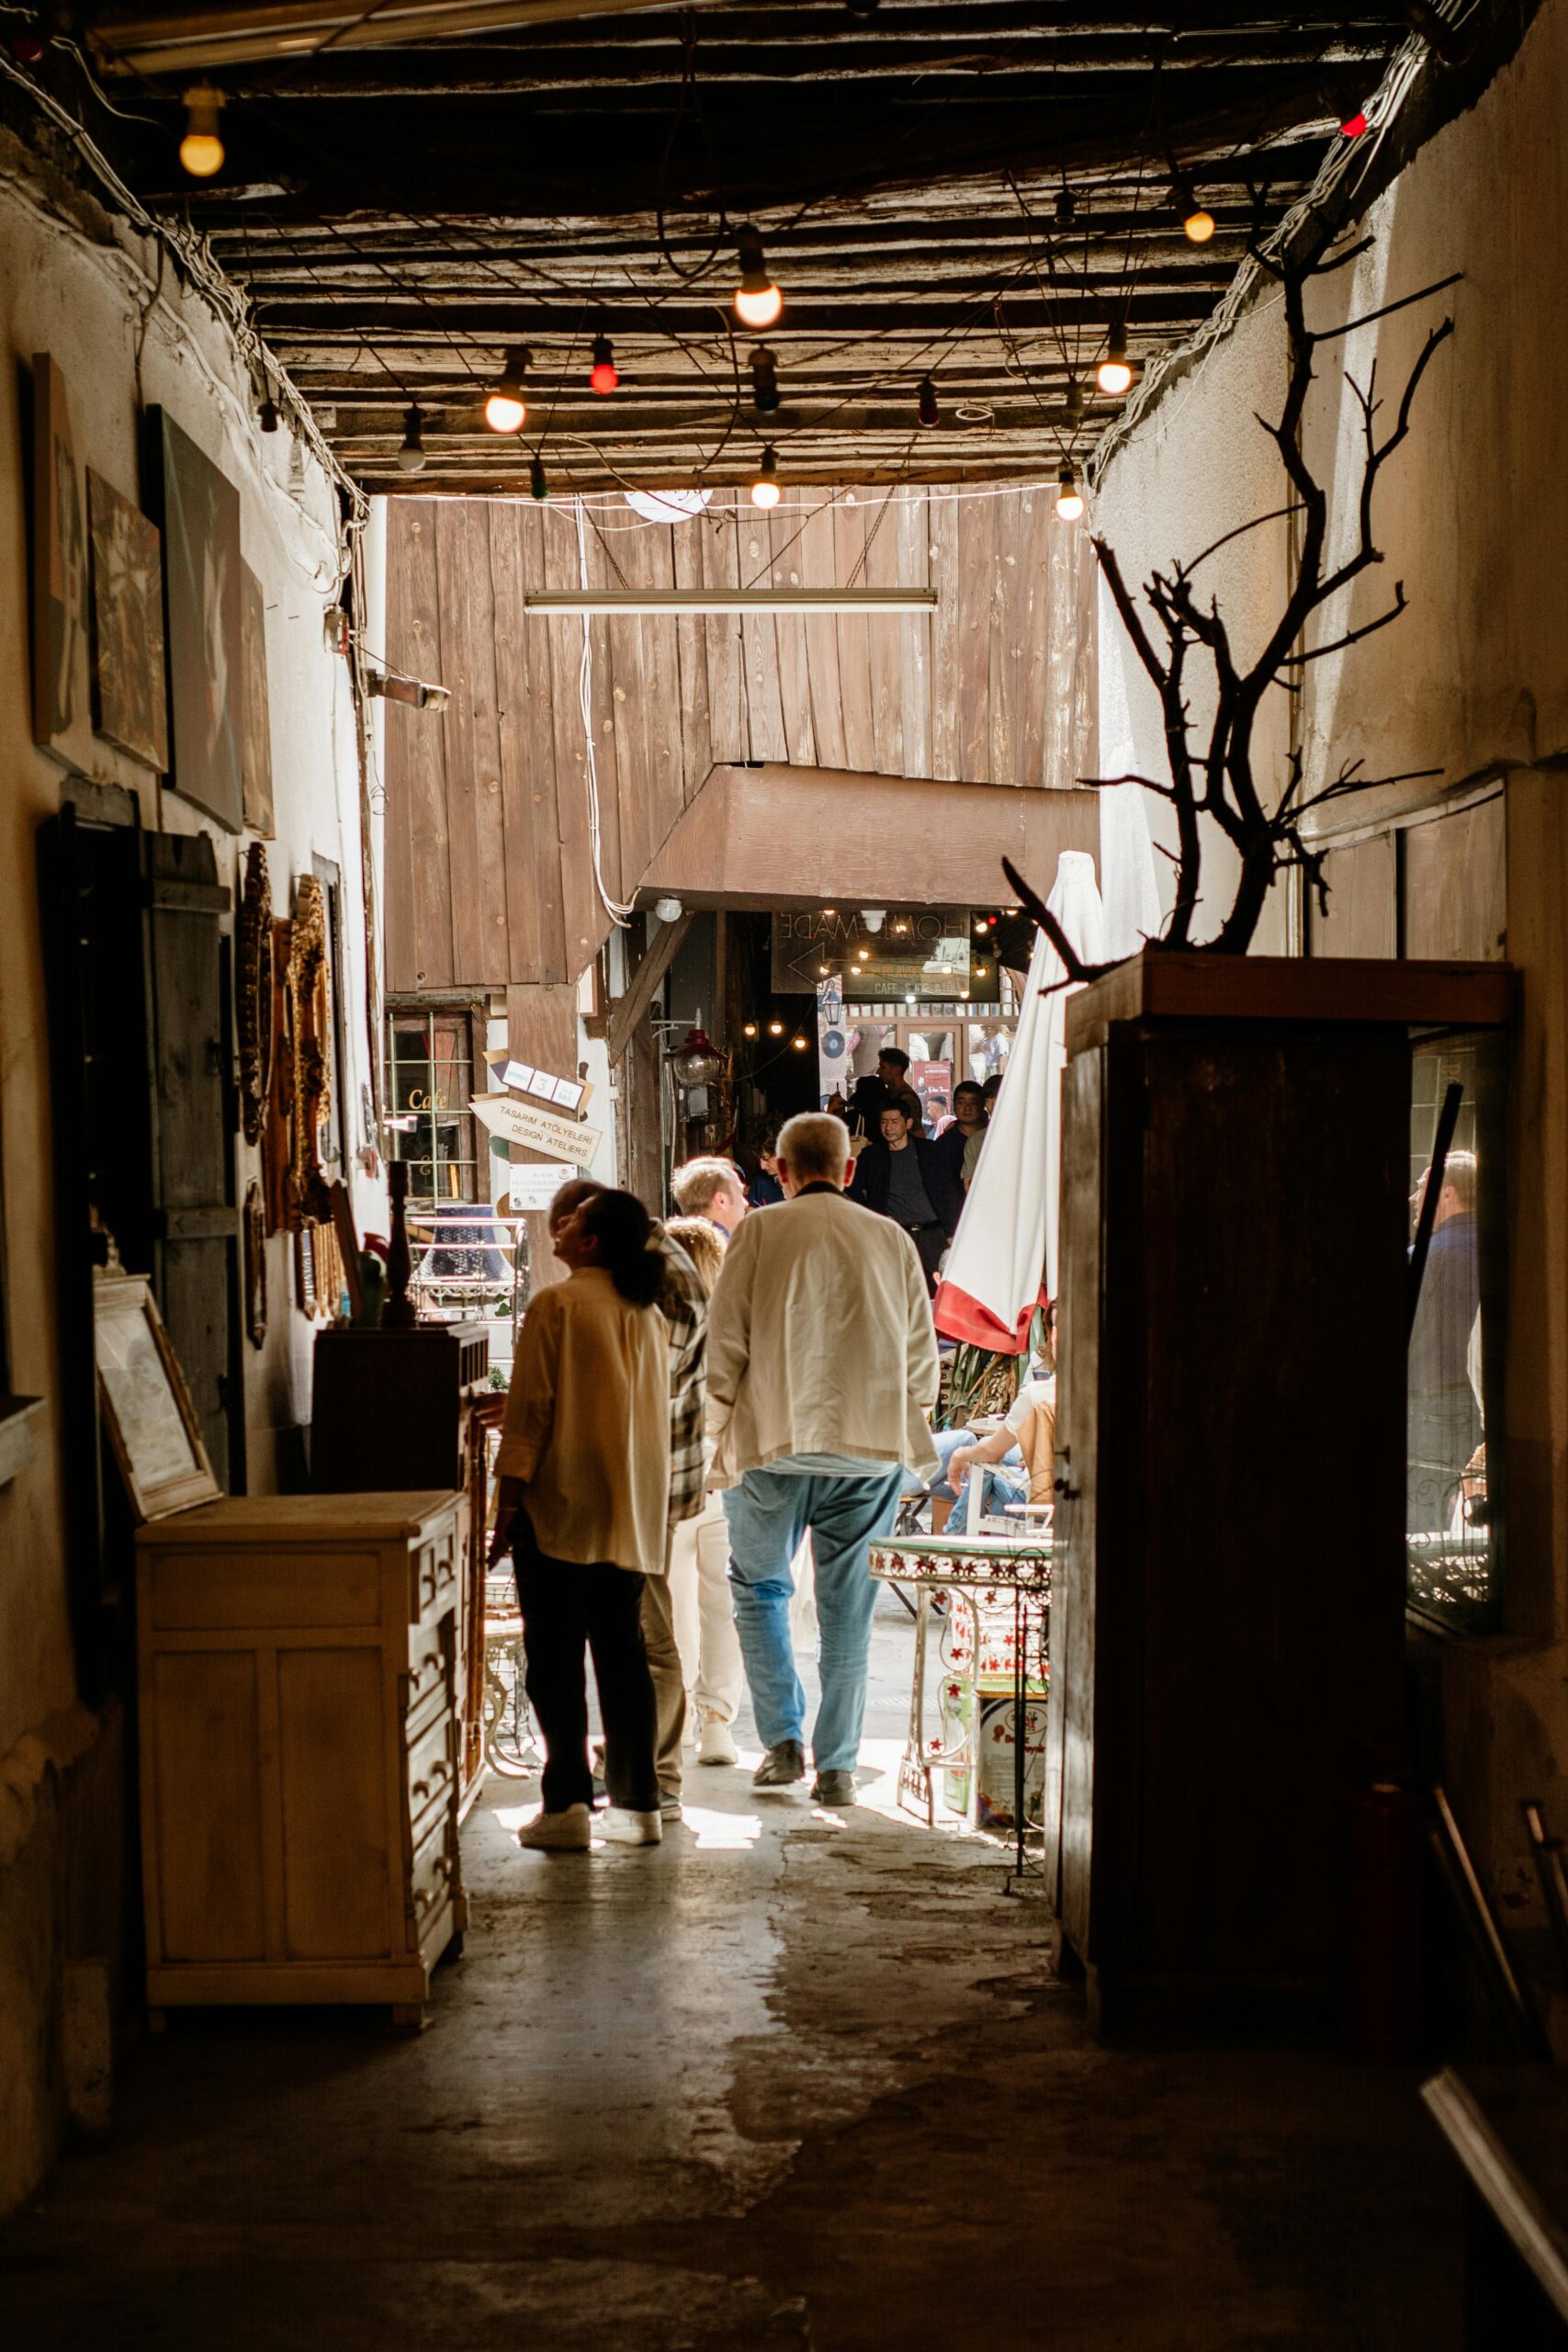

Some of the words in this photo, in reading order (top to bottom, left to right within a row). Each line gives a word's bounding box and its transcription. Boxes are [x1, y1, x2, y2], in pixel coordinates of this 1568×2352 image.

[874, 982, 897, 994] CAFE
[409, 1089, 447, 1110] Cafe
[500, 1105, 537, 1125] TASARIM
[541, 1120, 593, 1146] ATÖLYELERİ
[512, 1124, 544, 1142] DESIGN
[547, 1137, 588, 1158] ATELIERS
